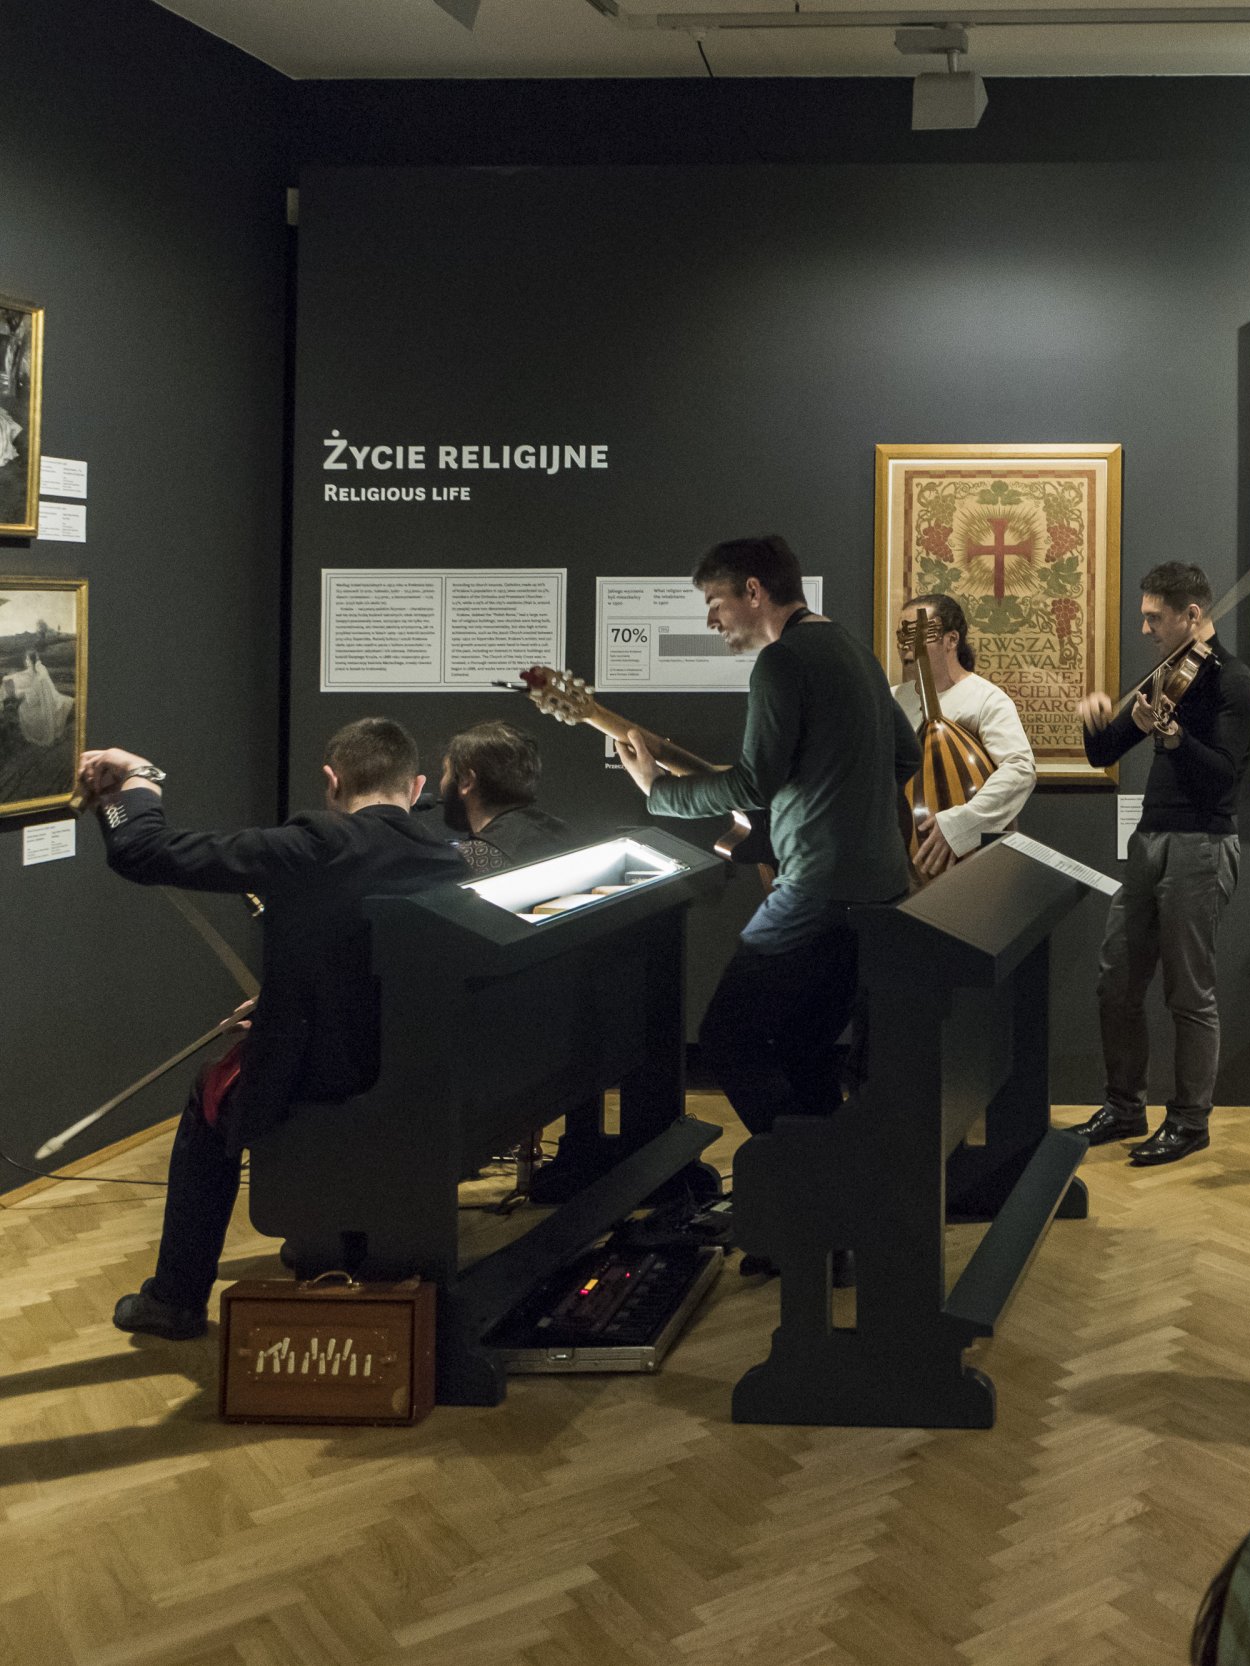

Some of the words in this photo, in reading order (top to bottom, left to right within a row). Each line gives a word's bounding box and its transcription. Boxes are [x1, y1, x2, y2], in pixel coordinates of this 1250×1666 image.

[439, 445, 608, 474] RELIGIJNE
[432, 488, 470, 500] LIFE
[611, 628, 648, 643] 70%
[1015, 699, 1081, 712] SKARG
